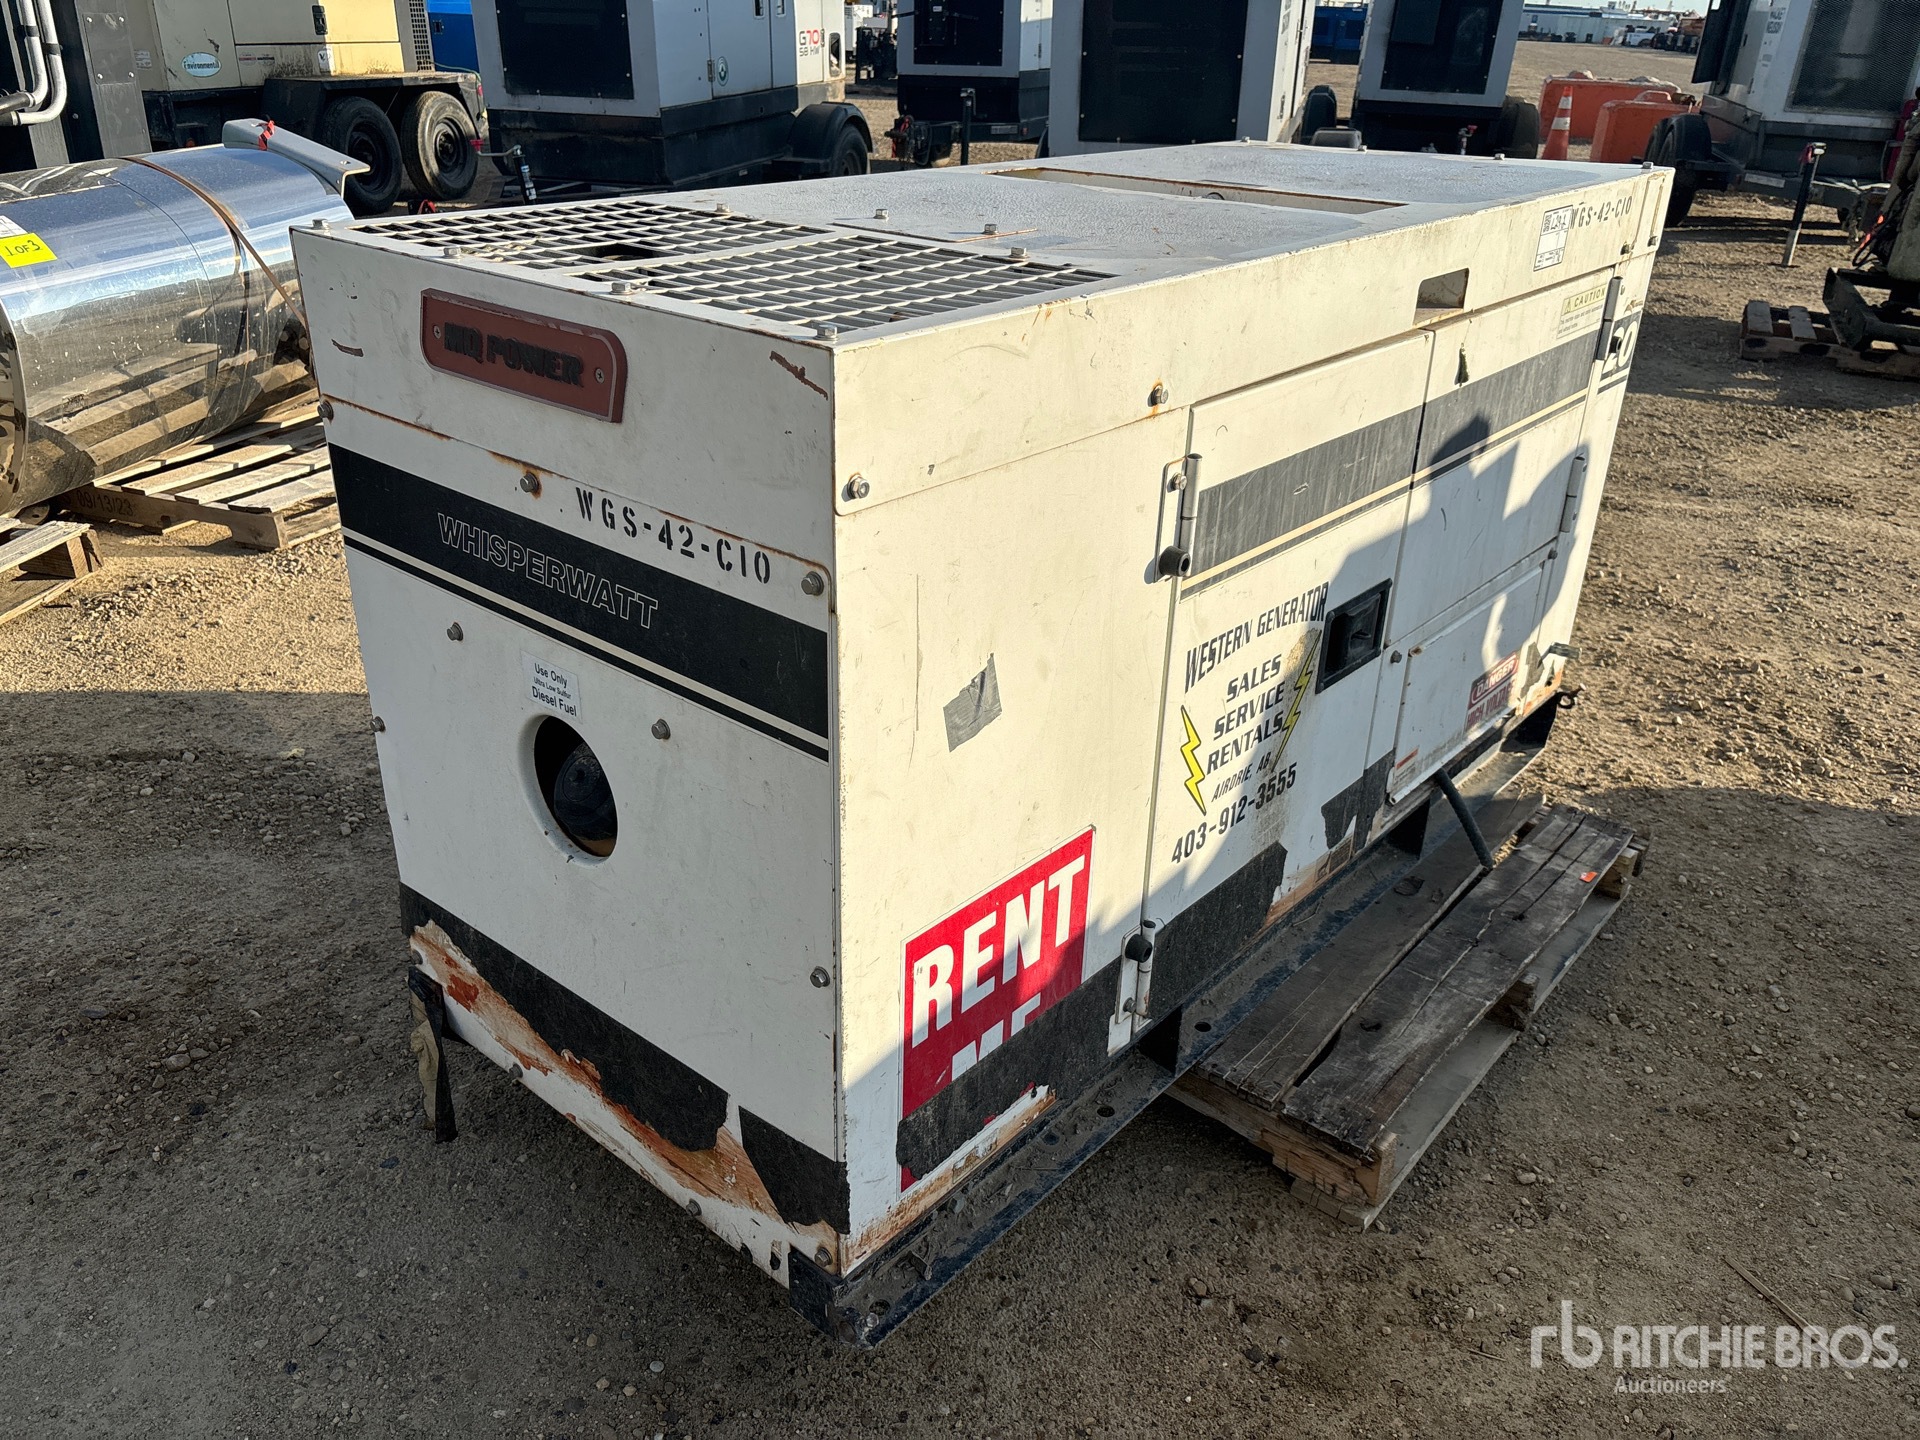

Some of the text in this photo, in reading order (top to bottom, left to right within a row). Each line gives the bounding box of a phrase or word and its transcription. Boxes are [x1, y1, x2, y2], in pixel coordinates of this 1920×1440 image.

[799, 29, 820, 46] G70
[14, 244, 29, 254] OF
[26, 239, 42, 251] 3
[1574, 286, 1607, 308] CAUTION
[444, 321, 585, 389] MQ POWER
[437, 512, 659, 630] WHISPERWATT
[1184, 580, 1330, 695] WESTERN GENERATOR
[533, 676, 546, 688] Ultra
[545, 682, 557, 693] Low
[534, 662, 568, 689] Use Only
[1226, 653, 1282, 703] SALES
[1476, 659, 1515, 698] DANGER
[532, 685, 577, 717] Diesel Fuel
[1213, 680, 1286, 742] SERVICE
[1206, 709, 1285, 776] RENTALS
[1170, 761, 1298, 865] 403-912-3555
[911, 854, 1086, 1049] RENT
